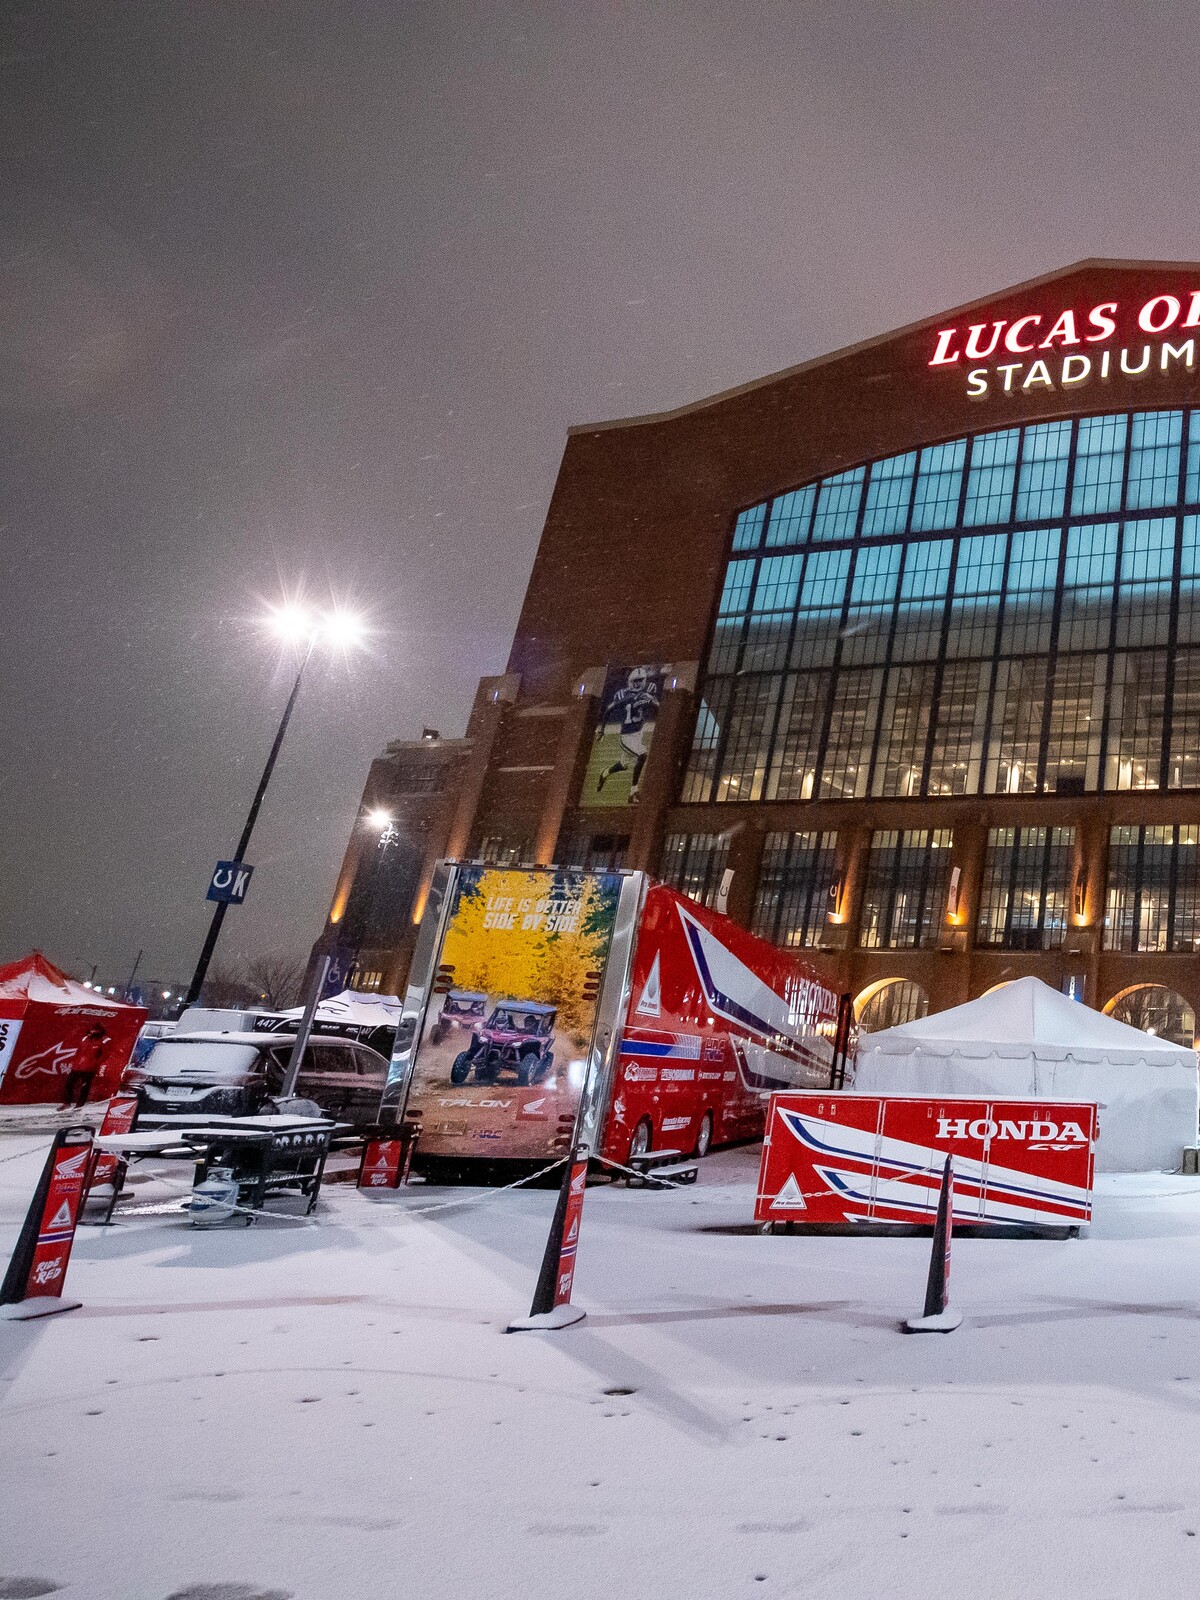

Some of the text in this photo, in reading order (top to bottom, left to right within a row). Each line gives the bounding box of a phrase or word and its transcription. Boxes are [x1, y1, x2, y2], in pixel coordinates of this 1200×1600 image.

[928, 303, 1118, 366] LUCAS
[966, 339, 1195, 396] STADIUM
[486, 897, 582, 914] LIFE IS BETTER
[483, 912, 579, 933] SIDE BY SIDE
[438, 1099, 513, 1108] TALON
[472, 1130, 503, 1139] HRC
[935, 1119, 1089, 1141] HONDA
[54, 1172, 85, 1180] HONDA
[36, 1257, 62, 1273] RIDE
[36, 1268, 62, 1285] RED
